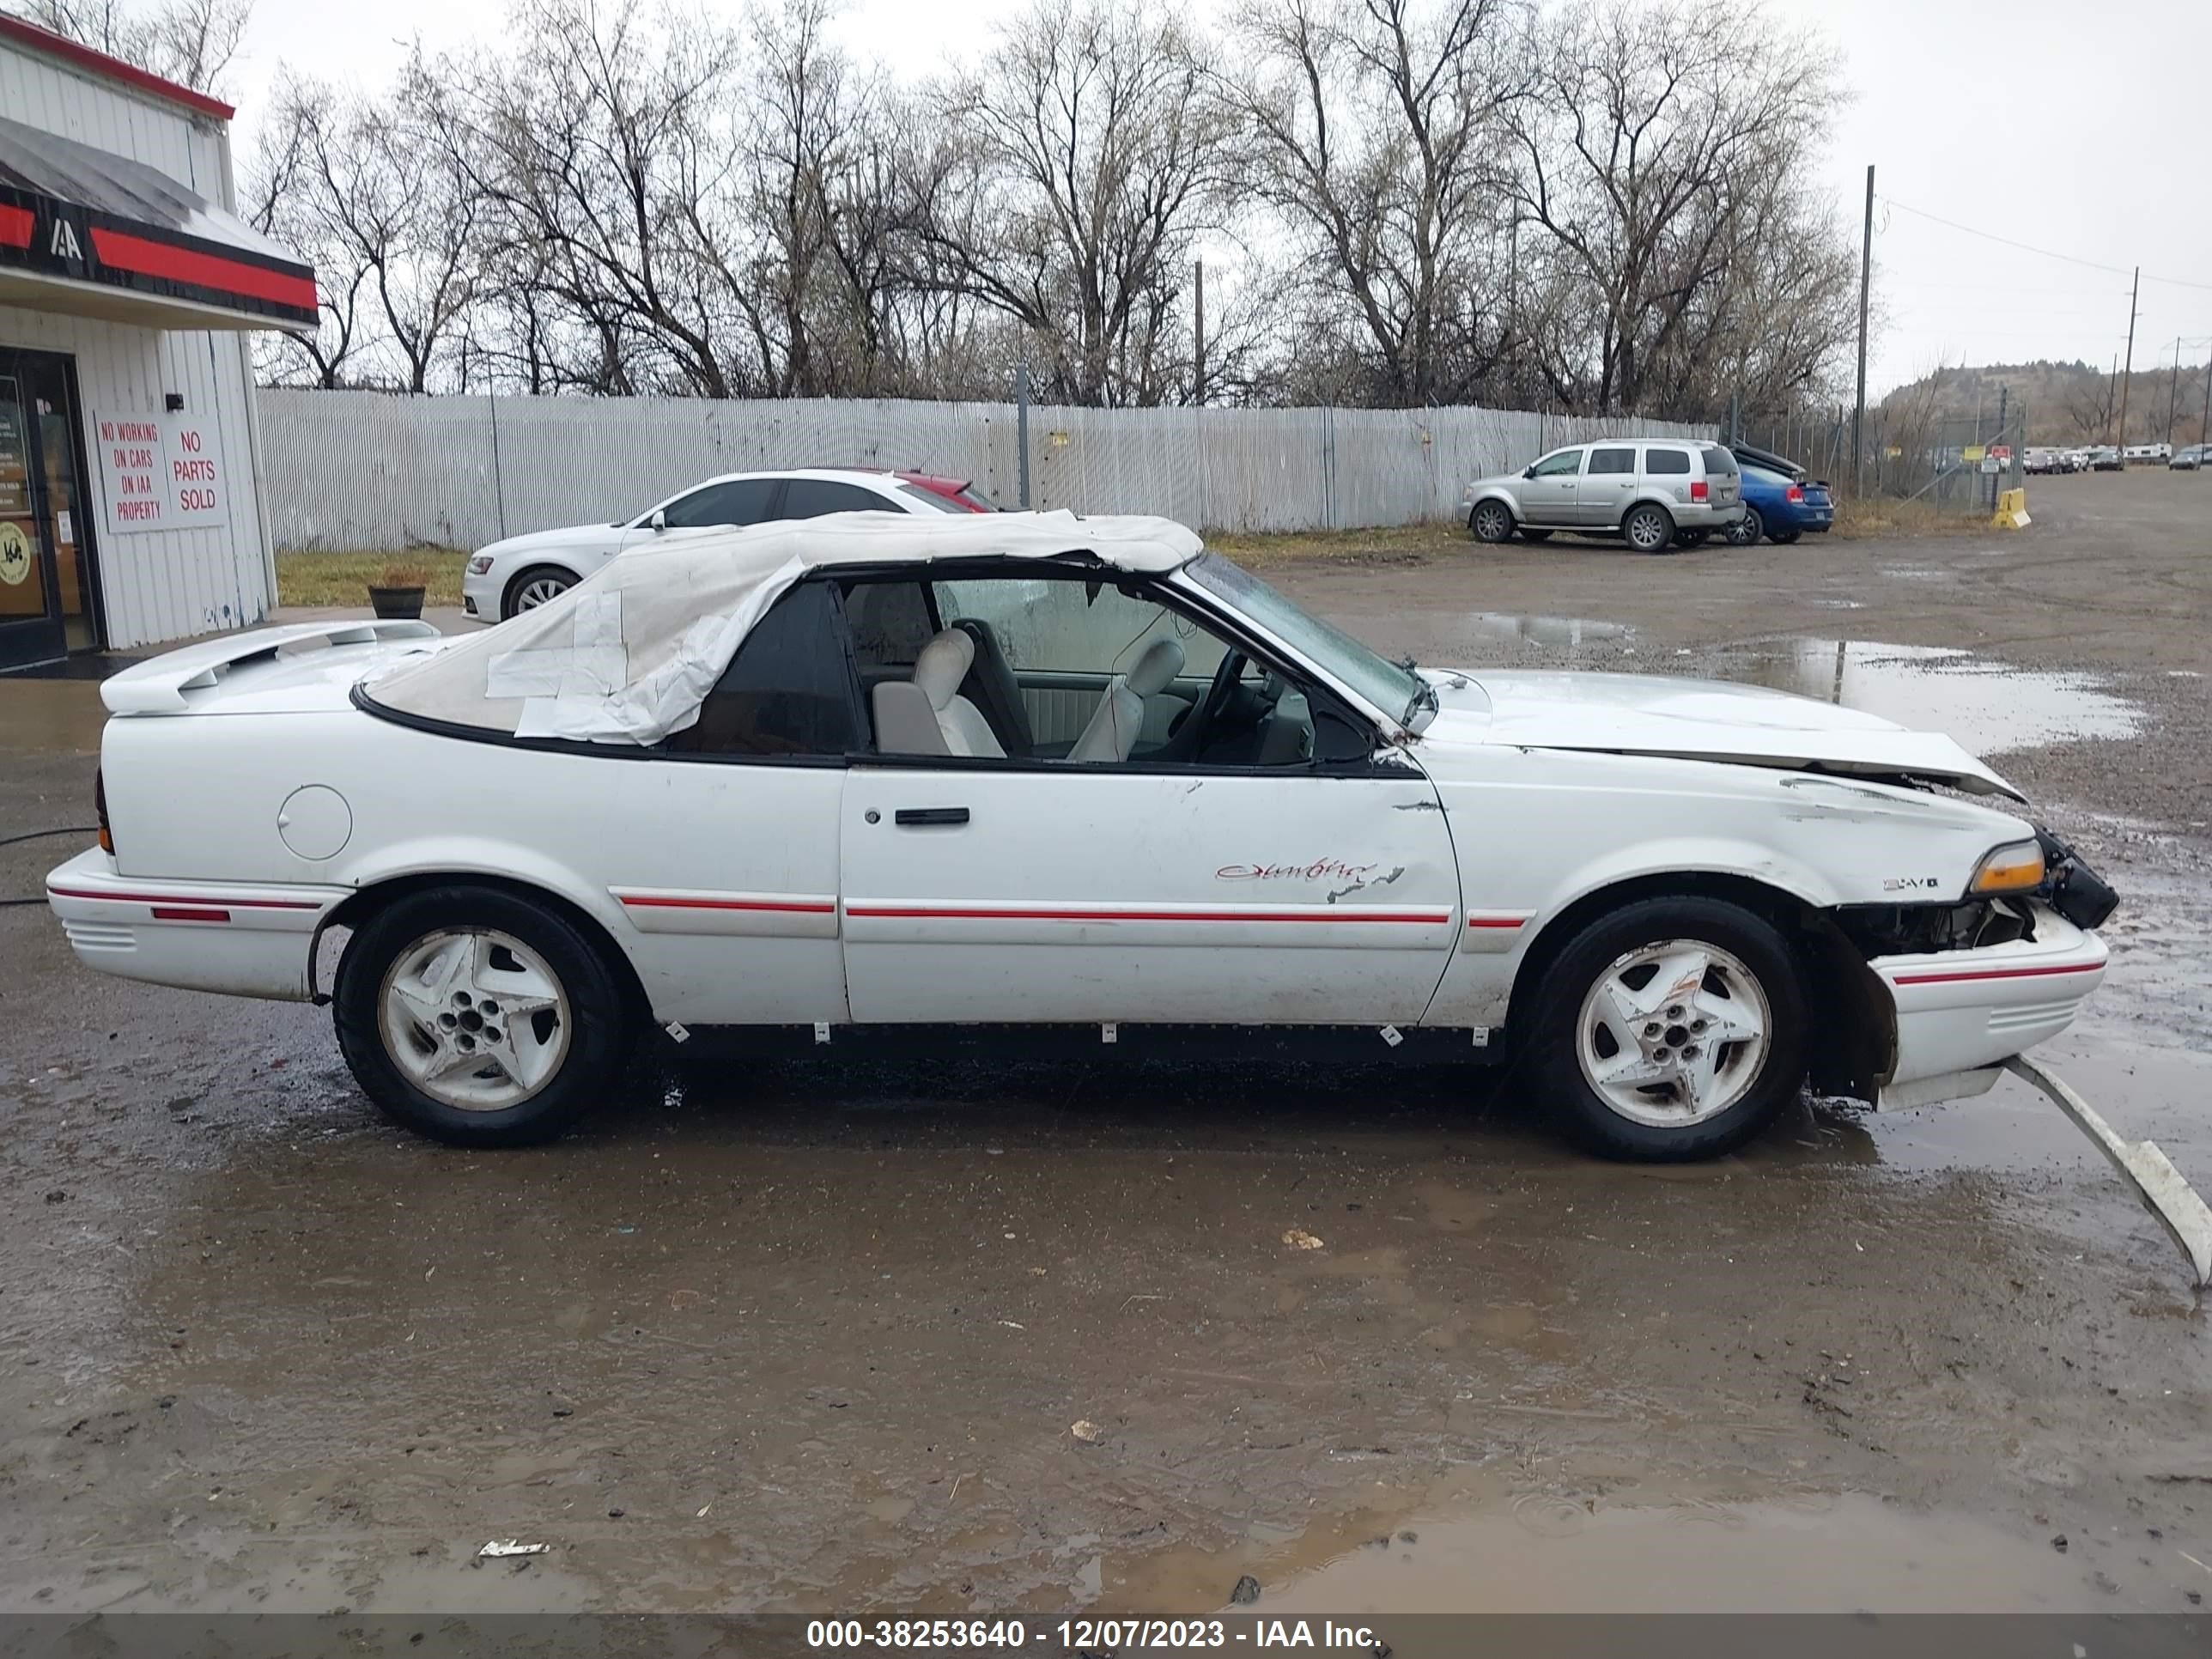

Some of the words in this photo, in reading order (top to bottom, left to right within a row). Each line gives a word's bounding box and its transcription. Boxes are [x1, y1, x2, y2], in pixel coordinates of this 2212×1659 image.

[101, 422, 114, 442] NO
[117, 422, 157, 442] WORKING
[180, 431, 200, 453] NO
[113, 449, 126, 468] ON
[129, 449, 153, 468] CARS
[173, 460, 215, 481] PARTS
[121, 475, 134, 495] ON
[137, 475, 152, 494] IAA
[180, 489, 216, 511] SOLD
[117, 501, 161, 522] PROPERTY
